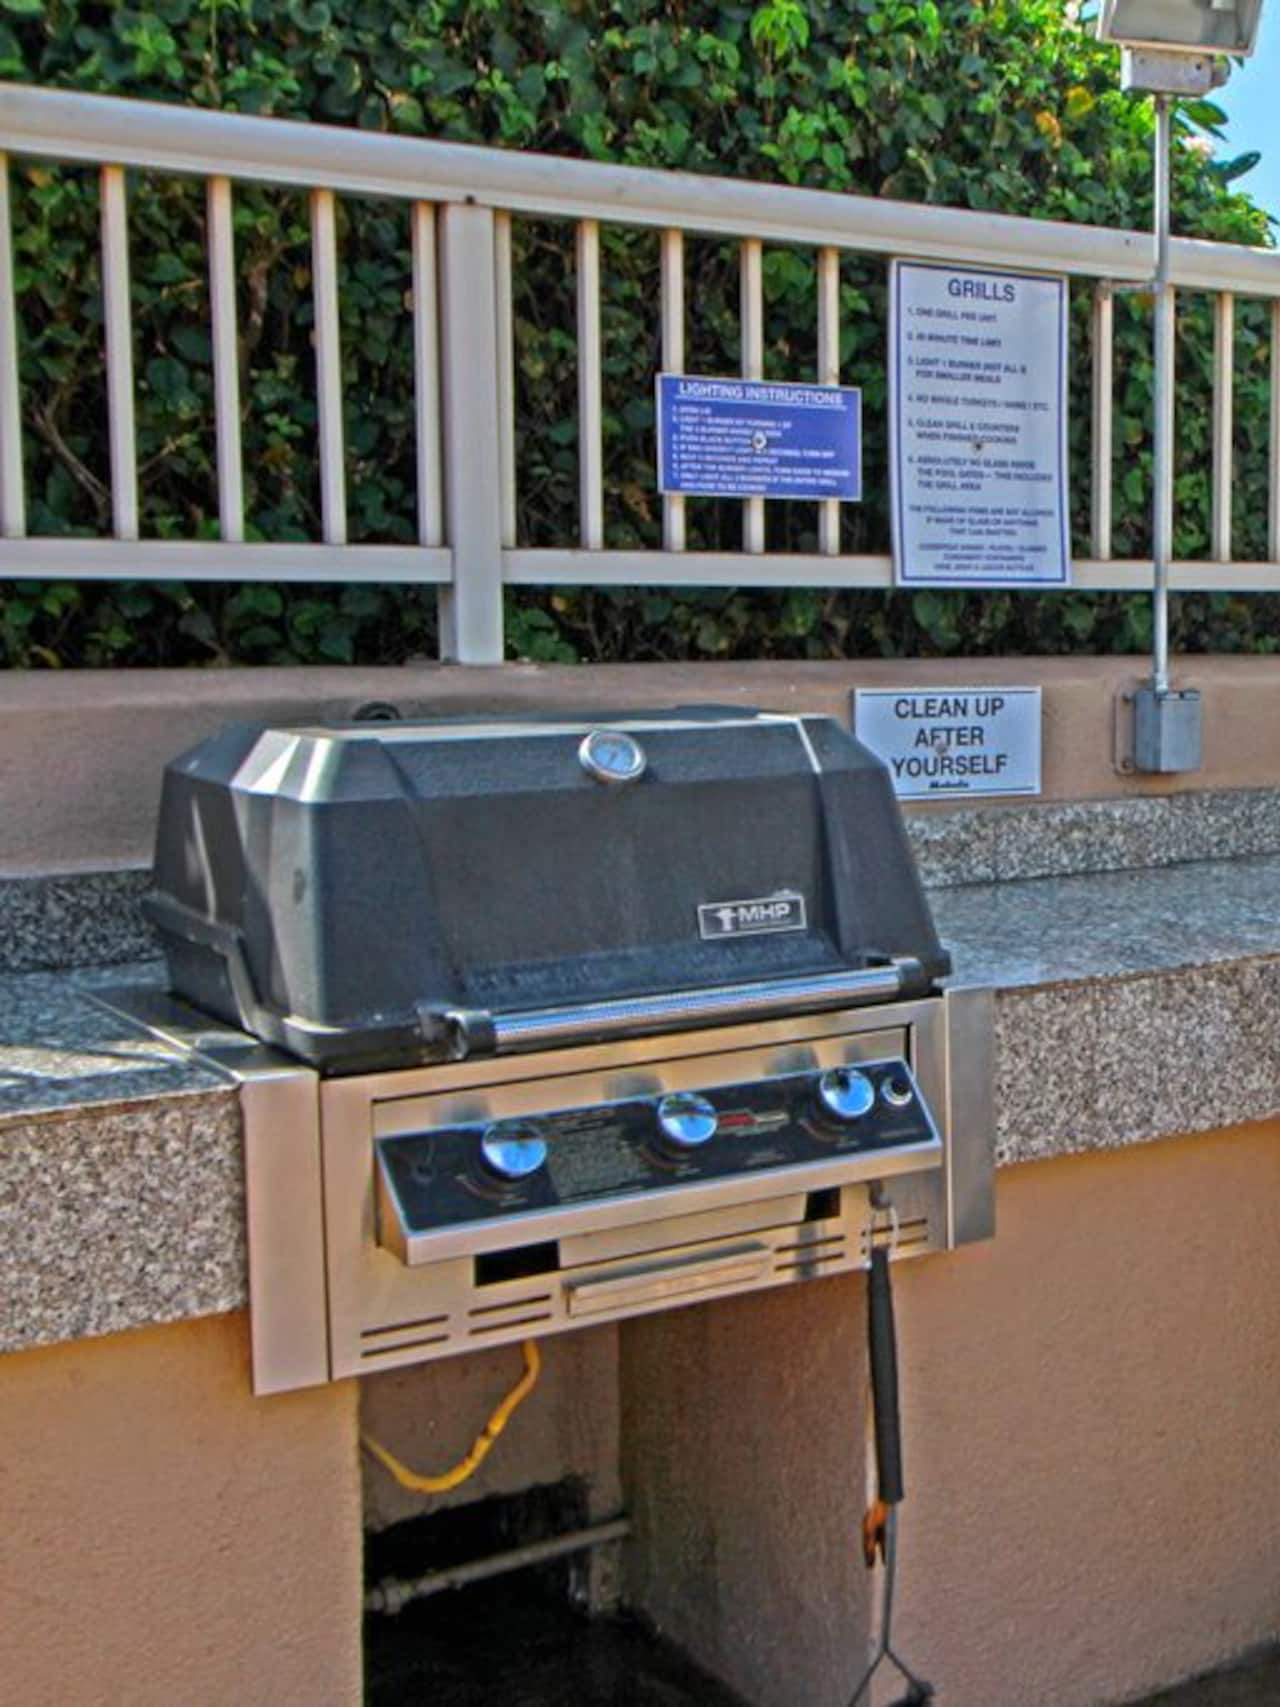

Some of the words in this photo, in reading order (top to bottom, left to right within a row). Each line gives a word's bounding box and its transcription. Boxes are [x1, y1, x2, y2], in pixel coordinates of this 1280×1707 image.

[948, 278, 1015, 302] GRILLS
[936, 308, 959, 320] GRILL
[961, 312, 977, 321] PER
[928, 333, 958, 344] MINUTE
[961, 336, 978, 346] TIME
[915, 357, 939, 366] LIGHT
[948, 360, 981, 369] BURNER
[915, 369, 932, 378] FOR
[936, 371, 971, 381] SMALLER
[679, 381, 744, 398] LIGHTING
[745, 386, 844, 406] INSTRUCTIONS
[915, 419, 943, 429] CLEAN
[895, 698, 968, 718] CLEAN
[975, 697, 1005, 717] UP
[914, 725, 984, 747] AFTER
[891, 754, 1008, 778] YOURSELF
[739, 903, 791, 922] MHP
